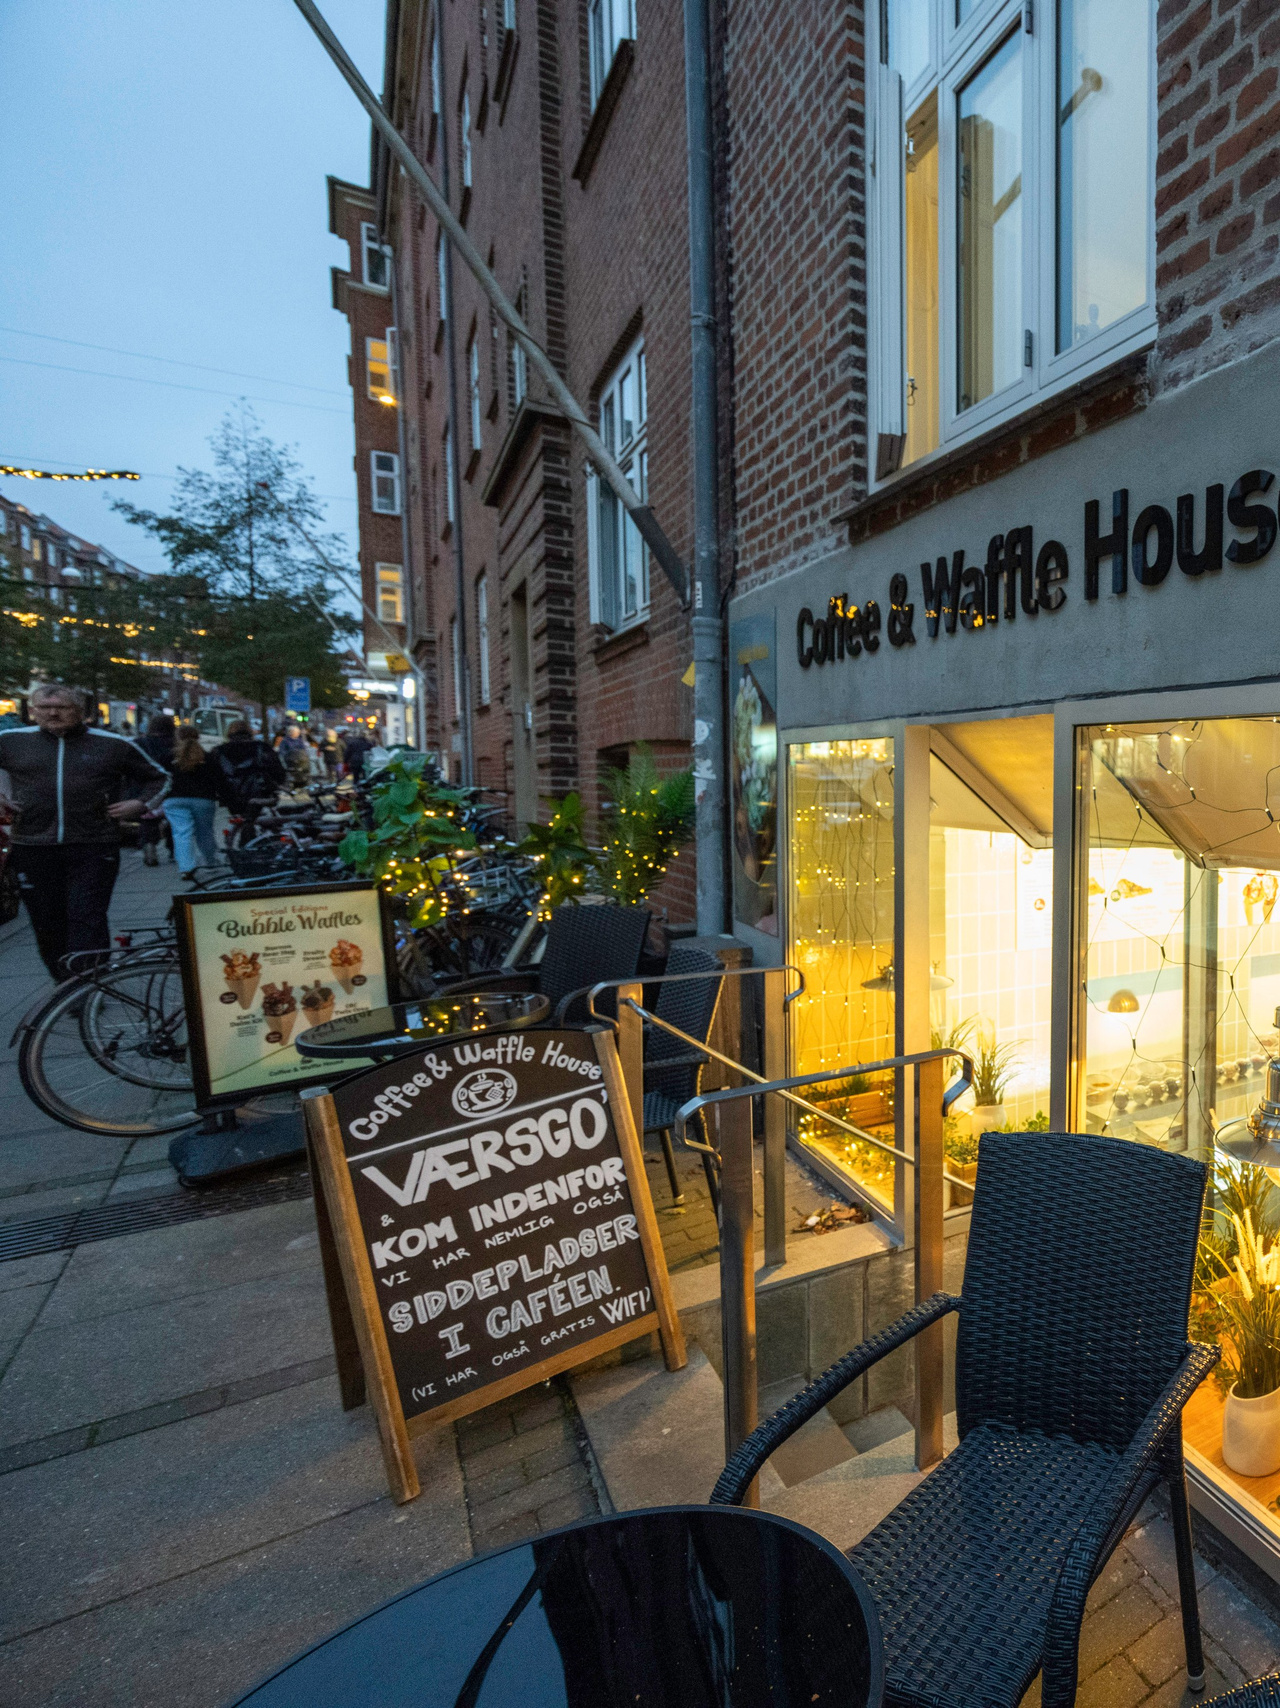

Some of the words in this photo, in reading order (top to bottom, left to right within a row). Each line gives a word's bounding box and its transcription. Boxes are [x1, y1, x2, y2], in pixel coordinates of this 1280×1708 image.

[797, 593, 881, 668] Coffee
[887, 573, 916, 648] &
[920, 524, 1068, 638] Waffle
[217, 917, 296, 938] Bubble
[297, 911, 362, 930] Waffles
[250, 906, 287, 917] Special
[349, 1072, 432, 1141] Coffee
[424, 1053, 452, 1079] &
[453, 1036, 535, 1065] Waffle
[541, 1040, 601, 1081] House
[371, 1216, 459, 1269] KOM
[469, 1157, 627, 1231] INDENFOR
[381, 1215, 395, 1227] &
[381, 1270, 411, 1288] VI
[432, 1247, 471, 1269] HAR
[484, 1215, 554, 1248] NEMLIG
[573, 1185, 625, 1215] OGSÅ
[388, 1214, 640, 1333] SIDDEPLADSER
[438, 1322, 470, 1359] I
[486, 1265, 621, 1339] CAFÉEN.
[411, 1383, 437, 1401] (VI
[445, 1367, 478, 1386] HAR
[492, 1341, 530, 1366] OGSÅ
[541, 1315, 596, 1345] GRATIS
[599, 1286, 650, 1325] WIFI)
